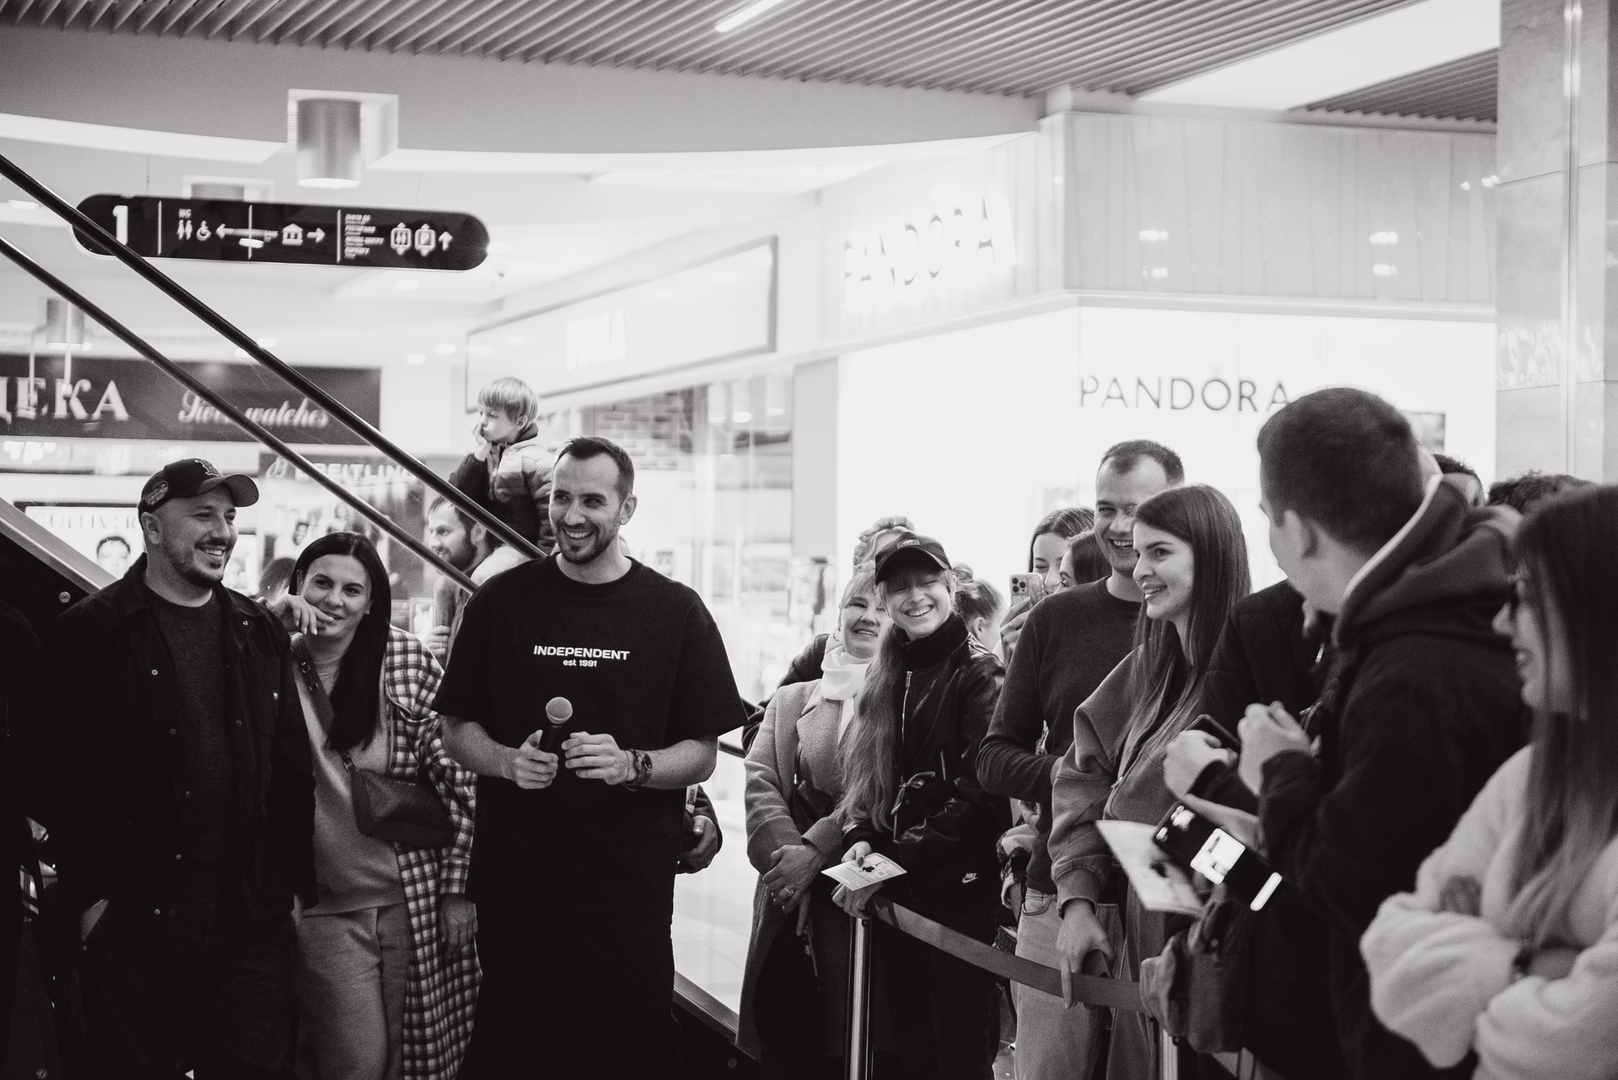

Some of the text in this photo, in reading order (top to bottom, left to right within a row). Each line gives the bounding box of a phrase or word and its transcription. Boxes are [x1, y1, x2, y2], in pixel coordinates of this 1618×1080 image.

[178, 207, 193, 219] WC
[111, 204, 129, 246] 1
[1080, 373, 1293, 412] PANDORA
[533, 644, 630, 661] INDEPENDENT
[562, 659, 598, 668] est 1991
